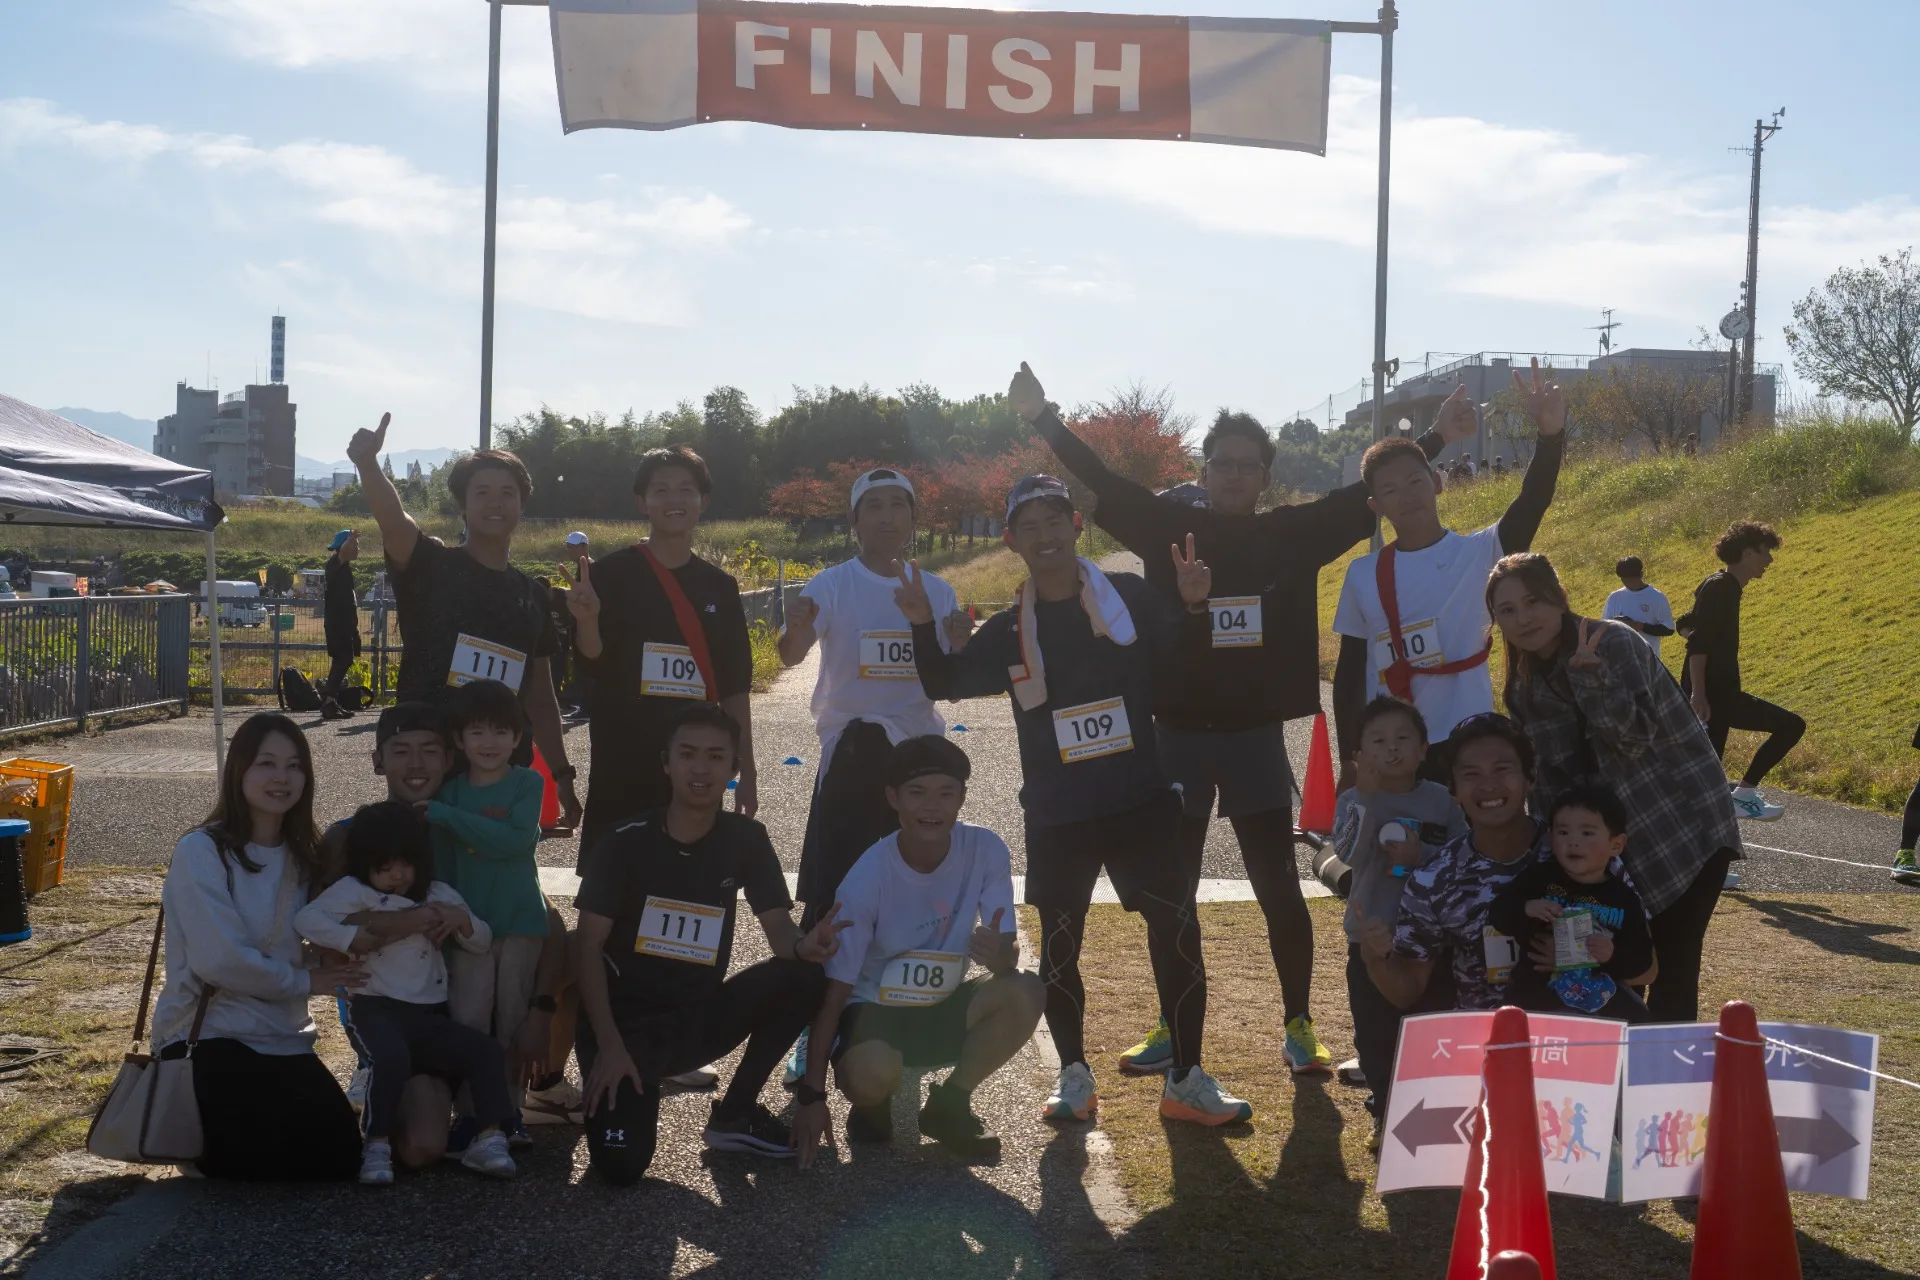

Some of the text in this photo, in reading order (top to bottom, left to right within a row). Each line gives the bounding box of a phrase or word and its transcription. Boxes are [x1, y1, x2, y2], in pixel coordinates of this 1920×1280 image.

[734, 20, 1142, 115] FINISH
[1209, 609, 1248, 631] 104
[472, 651, 509, 681] 111
[877, 641, 913, 663] 105
[661, 657, 697, 681] 109
[1071, 713, 1114, 742] 109
[661, 913, 702, 943] 111
[902, 962, 945, 989] 108
